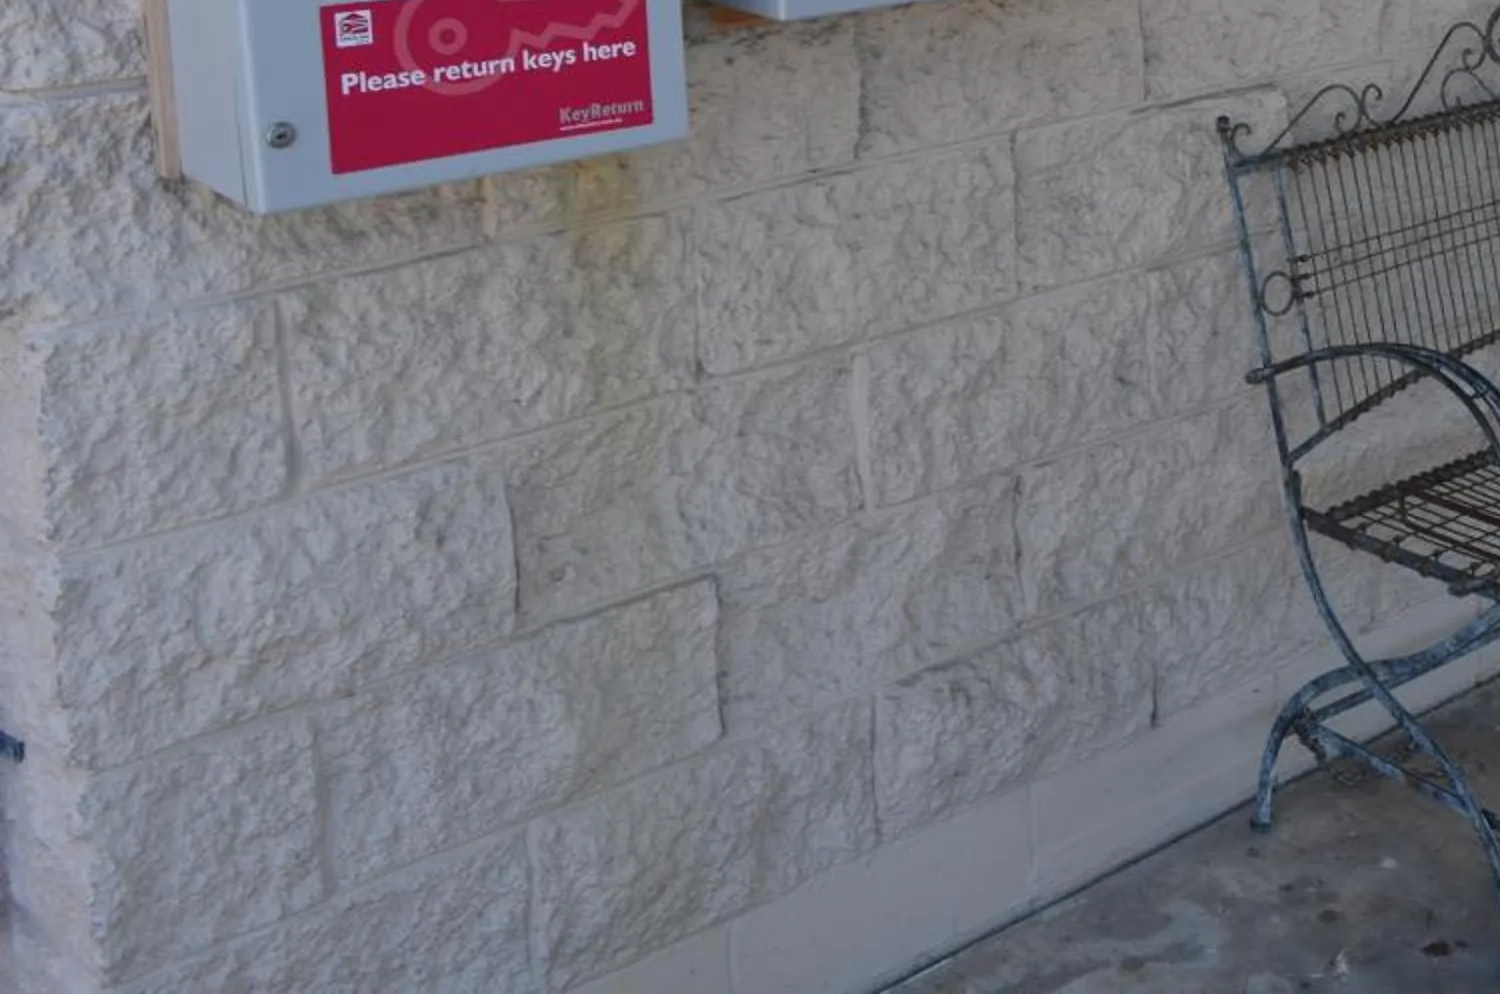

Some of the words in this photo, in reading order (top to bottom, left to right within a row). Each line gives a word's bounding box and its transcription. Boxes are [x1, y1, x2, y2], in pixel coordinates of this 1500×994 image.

[341, 69, 425, 95] Please
[432, 56, 516, 83] return
[522, 48, 577, 75] keys
[583, 39, 636, 63] here
[559, 99, 644, 124] KeyReturn
